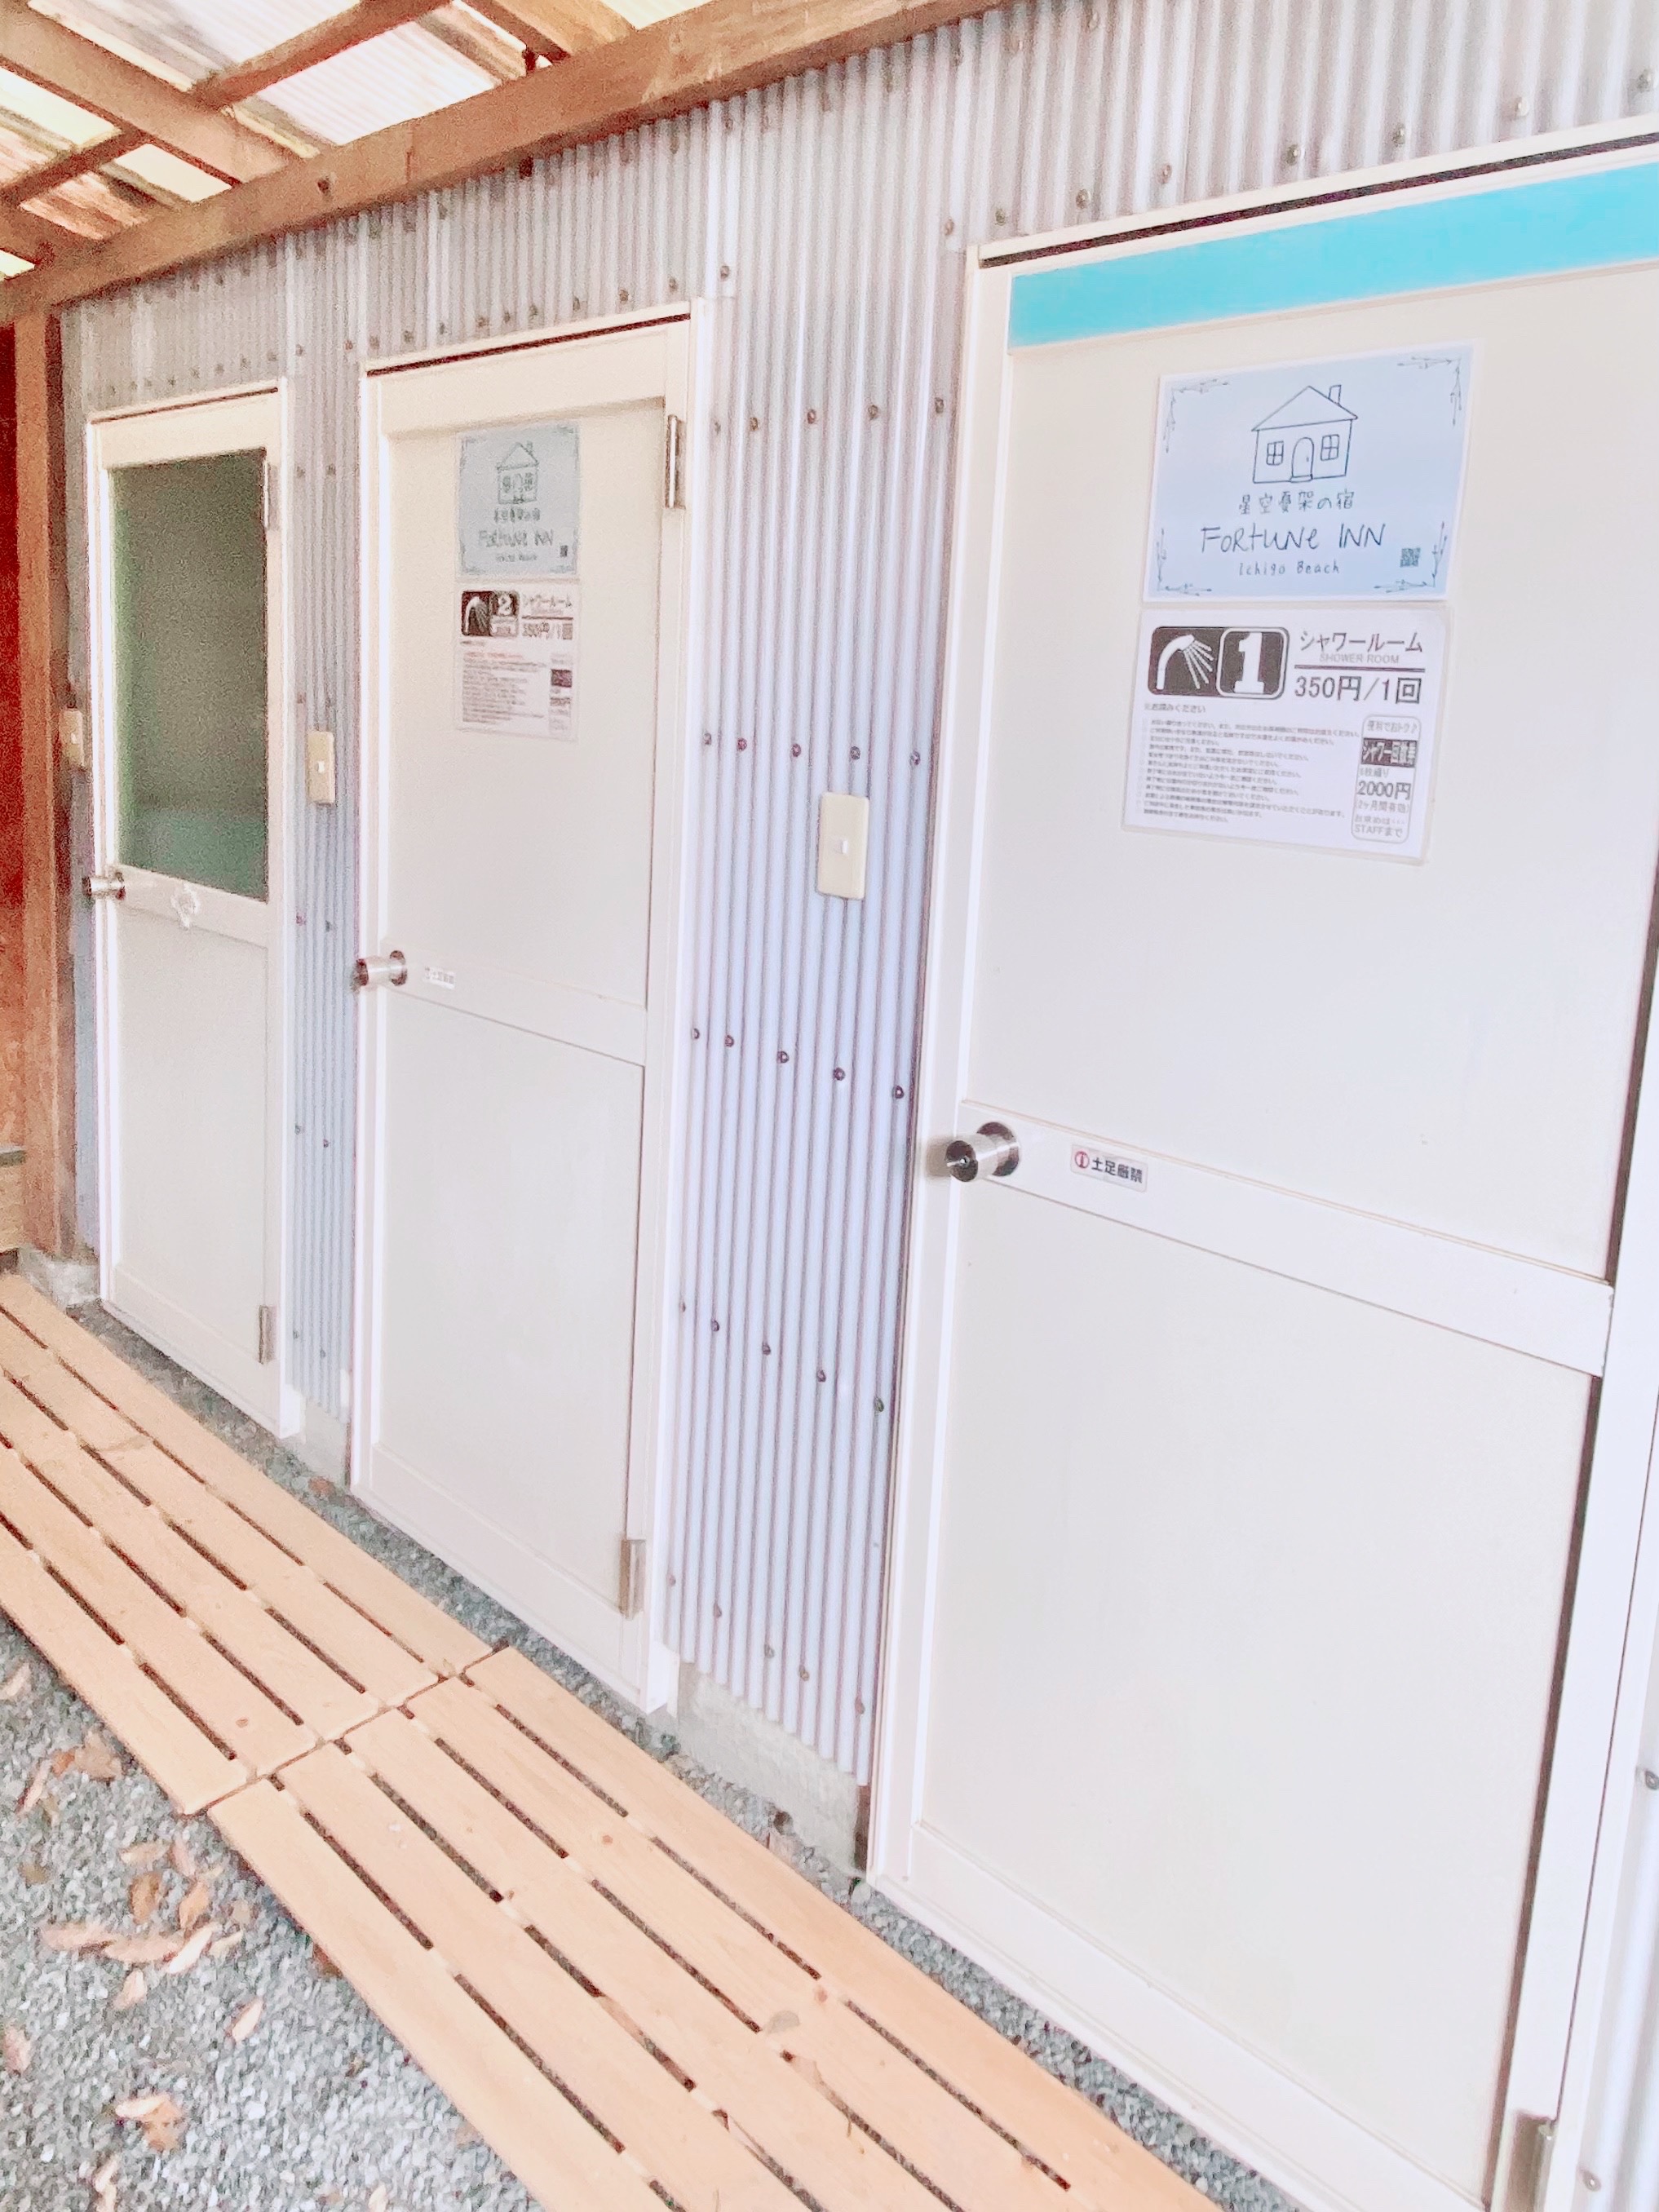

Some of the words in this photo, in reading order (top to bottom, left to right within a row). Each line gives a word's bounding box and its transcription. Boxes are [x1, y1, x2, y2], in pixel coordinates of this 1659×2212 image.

[1338, 523, 1386, 549] INN
[1297, 560, 1339, 574] Beach
[1300, 631, 1423, 653] シャワールーム
[1233, 631, 1265, 693] 1
[1319, 653, 1364, 663] SHOWER
[1366, 654, 1400, 664] ROOM
[1294, 675, 1422, 704] 350円/1回
[1356, 780, 1412, 802] 2000円
